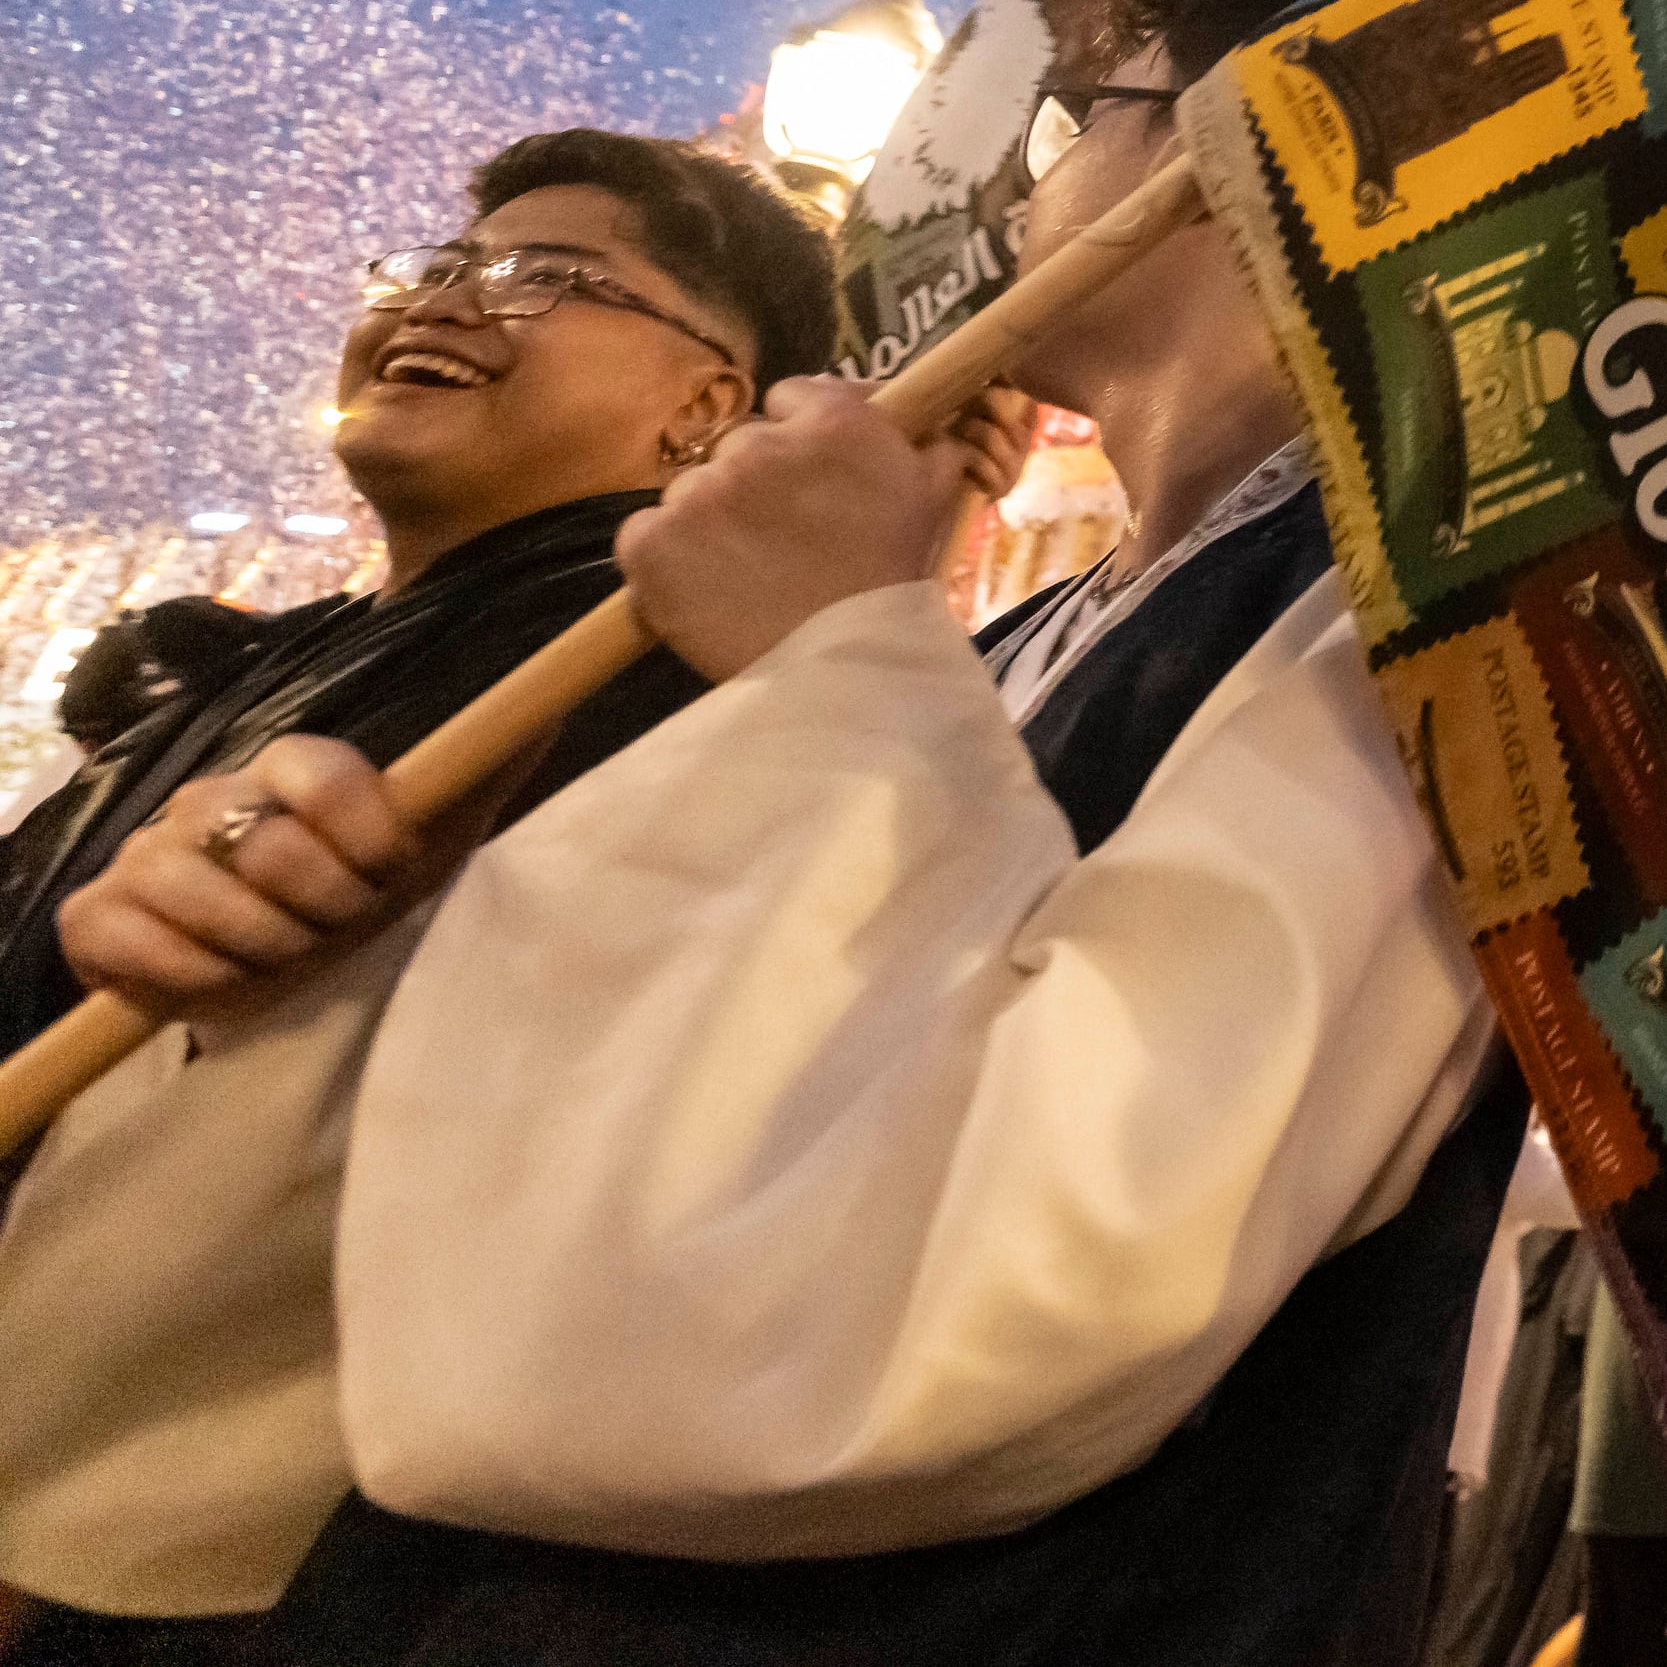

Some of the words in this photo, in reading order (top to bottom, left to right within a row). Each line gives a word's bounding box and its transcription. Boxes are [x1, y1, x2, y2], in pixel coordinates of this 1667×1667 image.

[1575, 15, 1620, 111] STAMP
[837, 229, 1002, 381] العالم
[1479, 646, 1533, 782] POSTAGE
[1510, 780, 1553, 881] STAMP
[1512, 948, 1580, 1074] POSTAGE
[1564, 1077, 1625, 1179] STAMP
